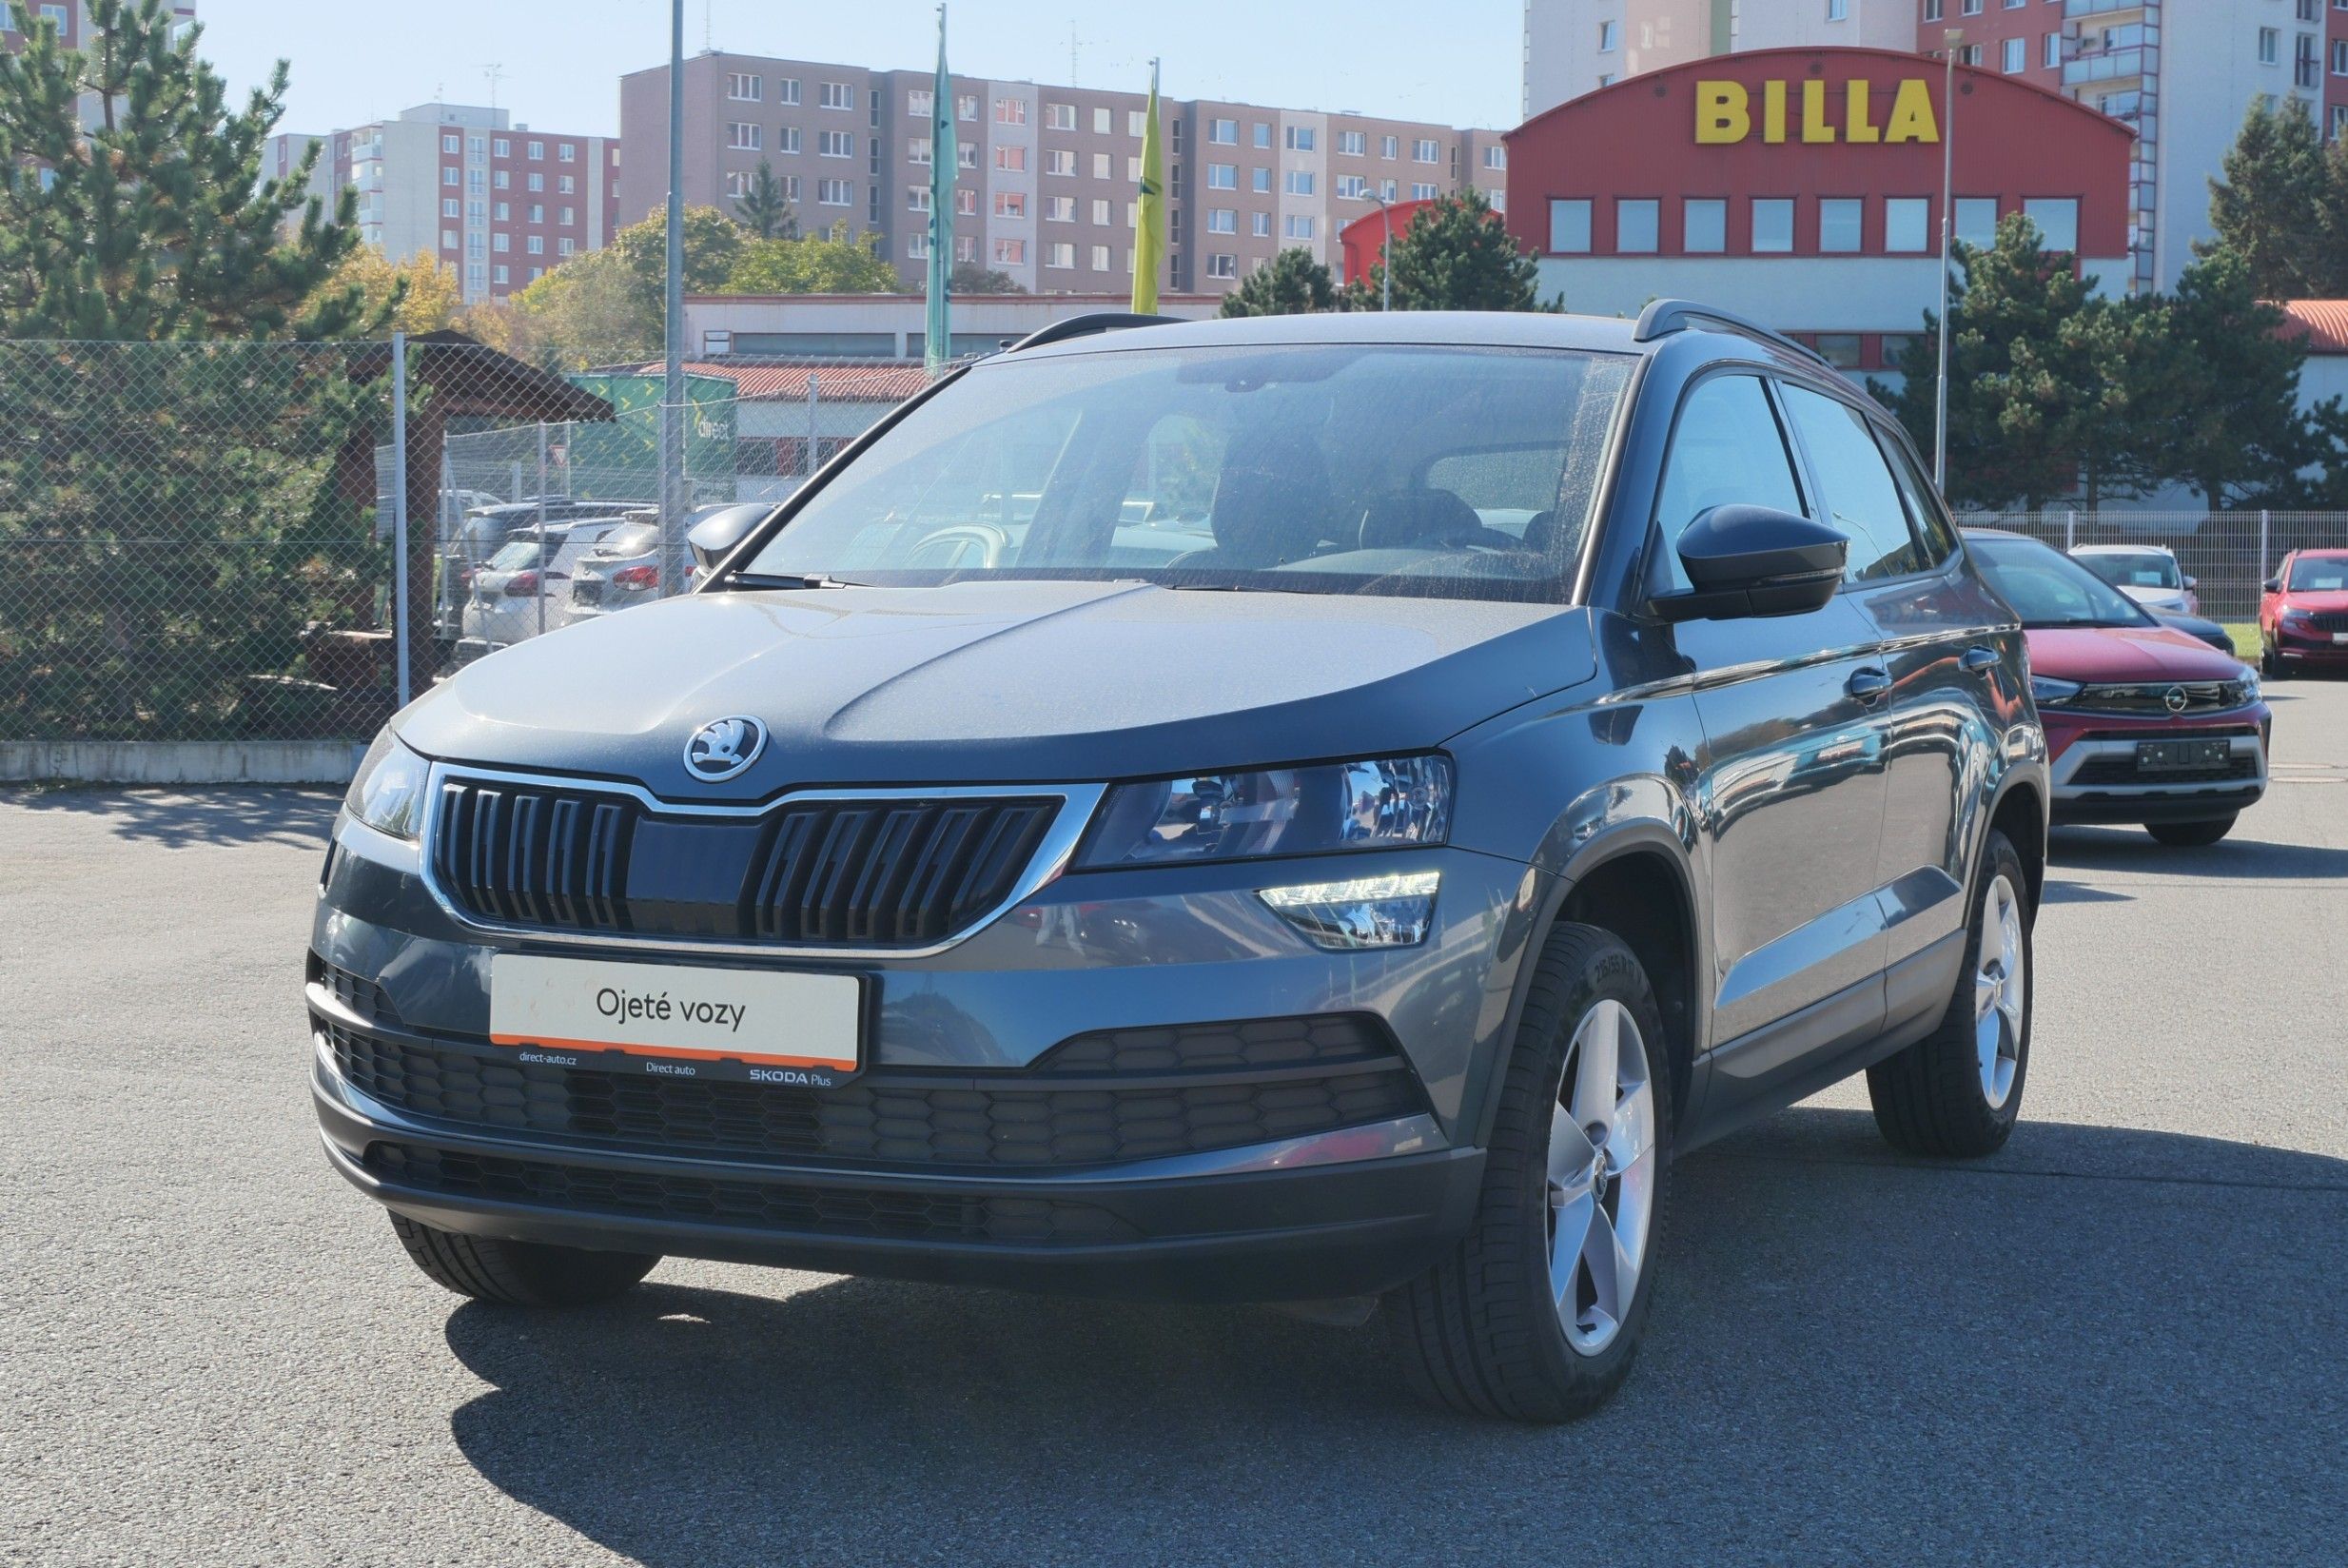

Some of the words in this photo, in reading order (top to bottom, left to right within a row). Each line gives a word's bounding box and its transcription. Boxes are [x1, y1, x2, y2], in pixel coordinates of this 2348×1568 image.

[1695, 79, 1940, 144] BILLA
[597, 988, 672, 1025] Ojeté
[679, 1001, 746, 1032] vozy
[519, 1051, 577, 1066] direct-auto.cz
[646, 1062, 674, 1074] Direct
[675, 1066, 695, 1076] auto
[811, 1073, 832, 1087] Plus
